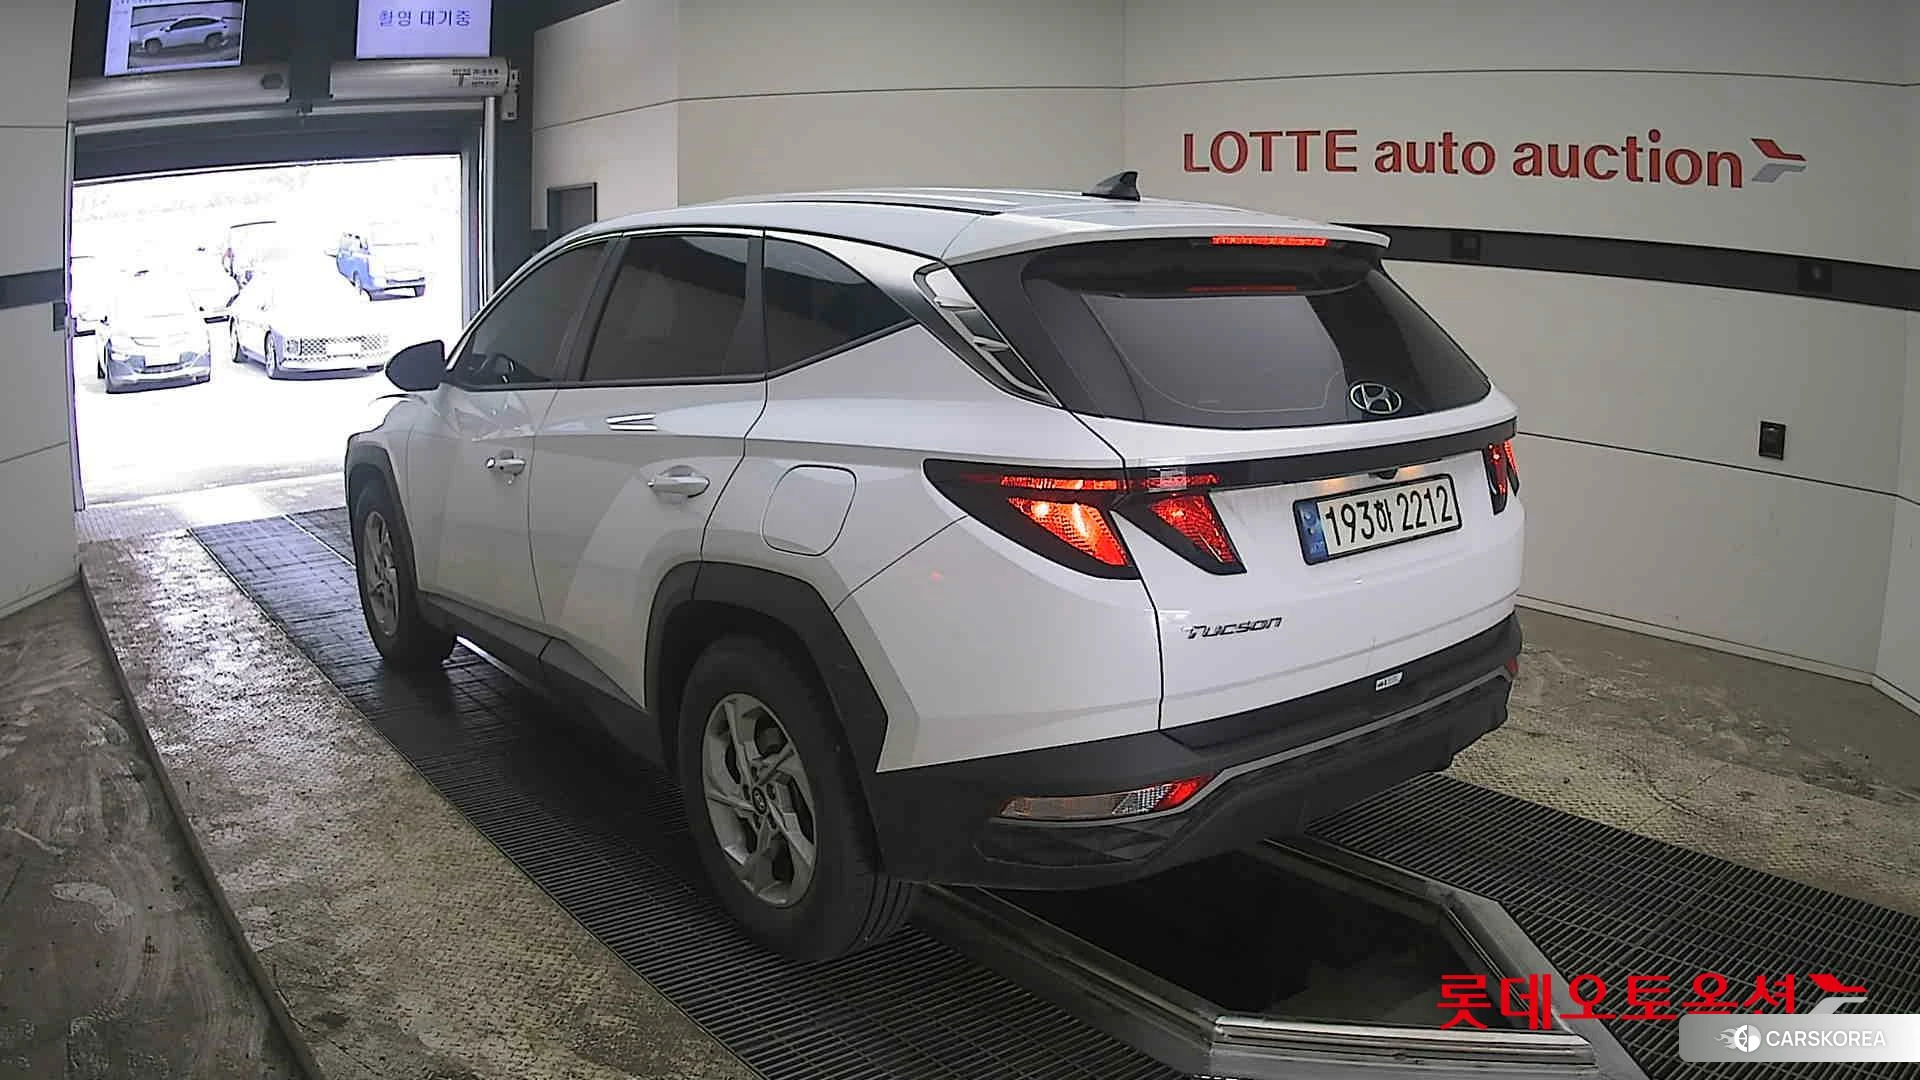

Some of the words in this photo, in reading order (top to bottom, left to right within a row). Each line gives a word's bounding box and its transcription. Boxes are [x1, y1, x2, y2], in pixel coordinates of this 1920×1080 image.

[420, 9, 471, 27] 대기중
[1183, 129, 1358, 174] LOTTE
[1374, 131, 1496, 175] auto
[1512, 129, 1744, 189] auction
[1324, 498, 1394, 547] 193하
[1396, 484, 1454, 532] 2212
